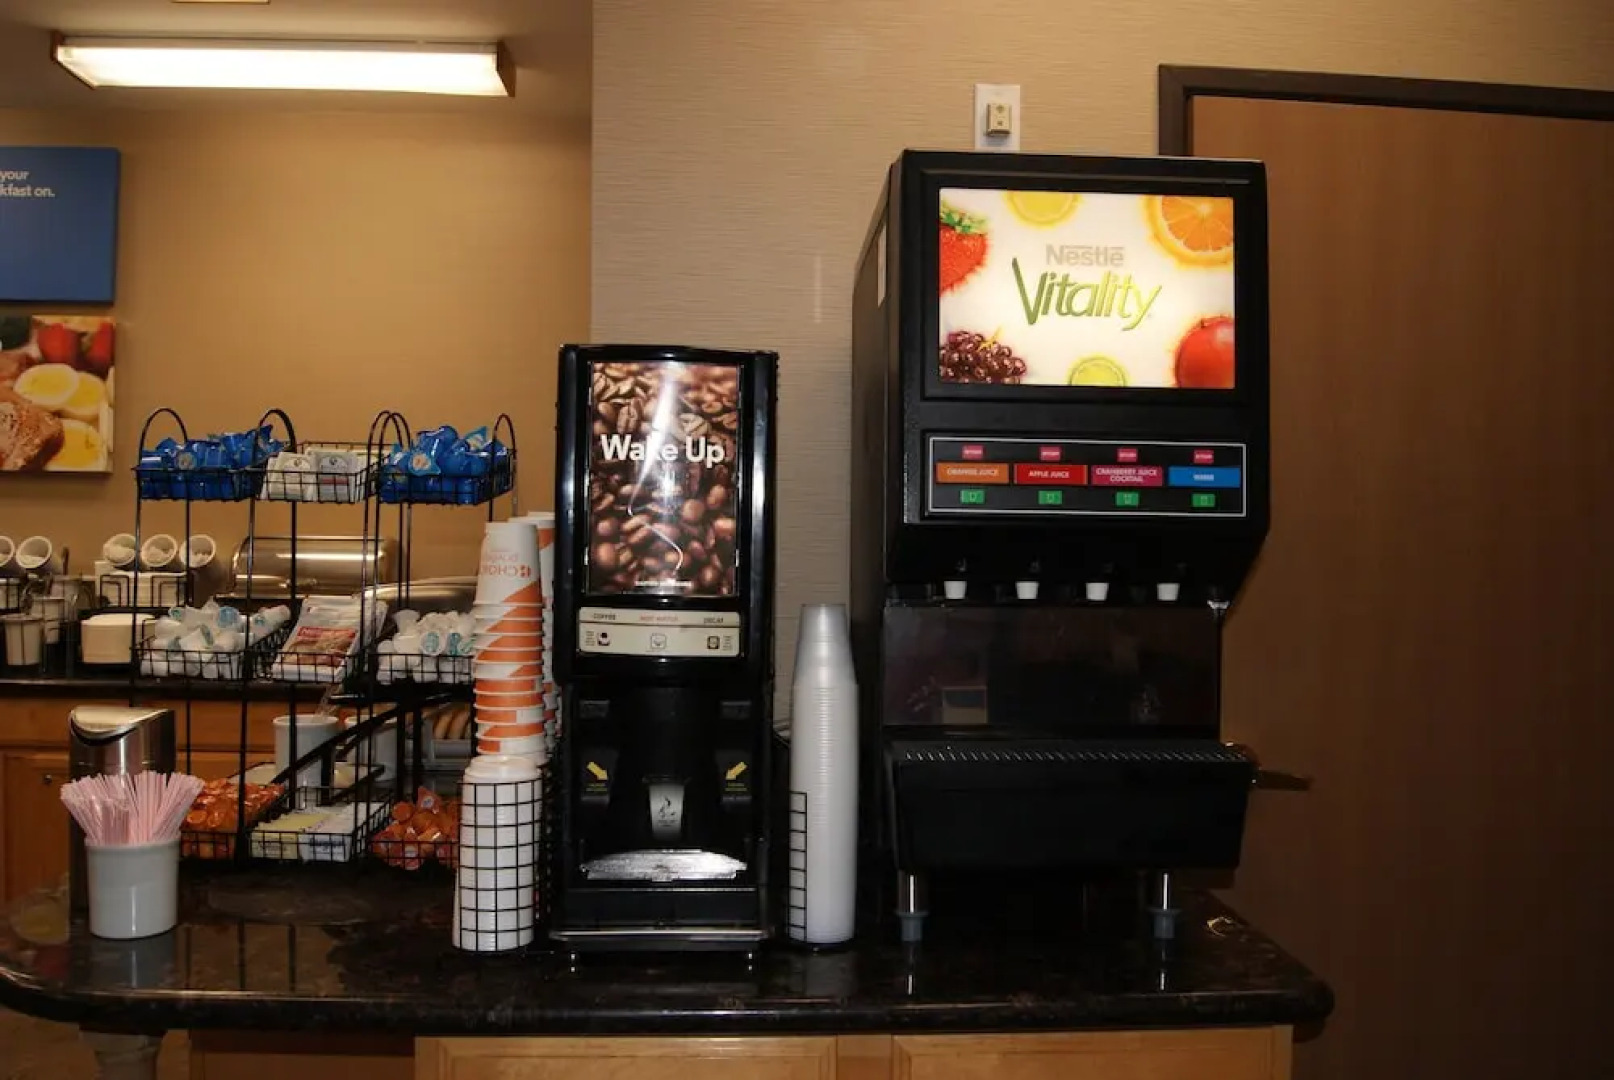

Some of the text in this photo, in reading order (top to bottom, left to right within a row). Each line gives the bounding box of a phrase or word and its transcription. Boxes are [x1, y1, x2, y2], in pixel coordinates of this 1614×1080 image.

[0, 170, 30, 182] your
[33, 187, 56, 198] on.
[1011, 257, 1163, 331] Vitality
[601, 433, 725, 469] Wake Up
[979, 468, 999, 477] JUICE
[1028, 470, 1070, 479] APPLE JUICE
[1095, 467, 1158, 476] CRANBERRY JUICE
